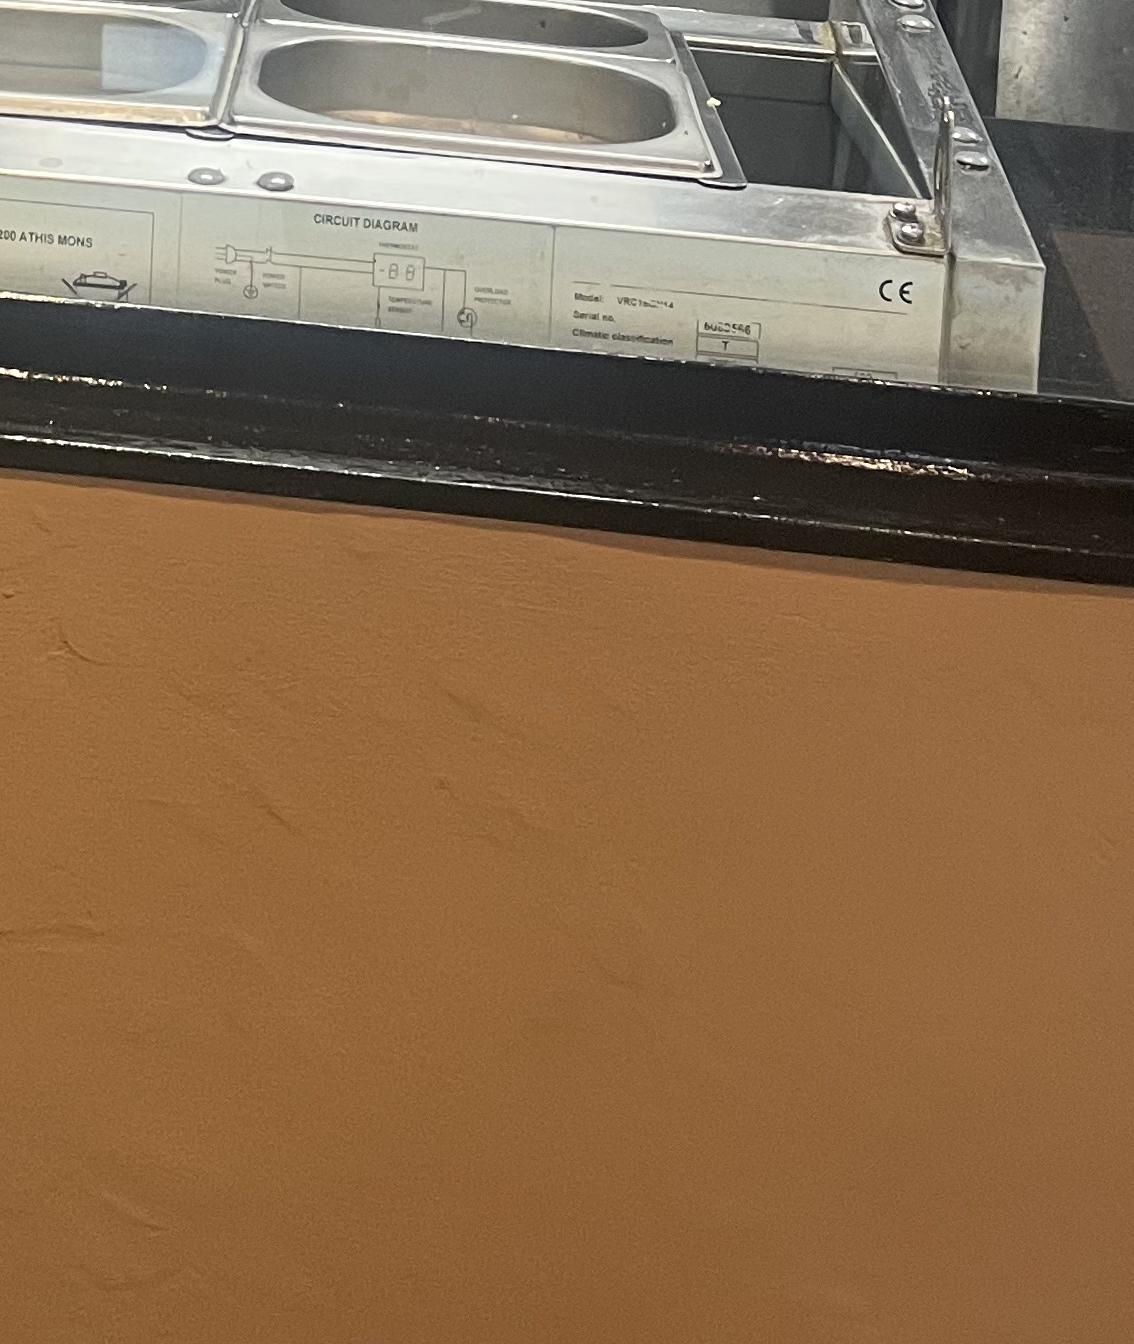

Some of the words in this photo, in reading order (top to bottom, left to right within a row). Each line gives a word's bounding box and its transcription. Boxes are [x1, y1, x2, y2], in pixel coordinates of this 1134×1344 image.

[313, 213, 360, 228] CIRCUIT
[363, 217, 418, 232] DIAGRAM
[19, 231, 55, 245] ATHIS
[57, 234, 93, 248] MONS
[878, 279, 913, 305] CE
[573, 310, 600, 321] Serial
[572, 328, 610, 340] Climatic
[721, 340, 729, 351] T
